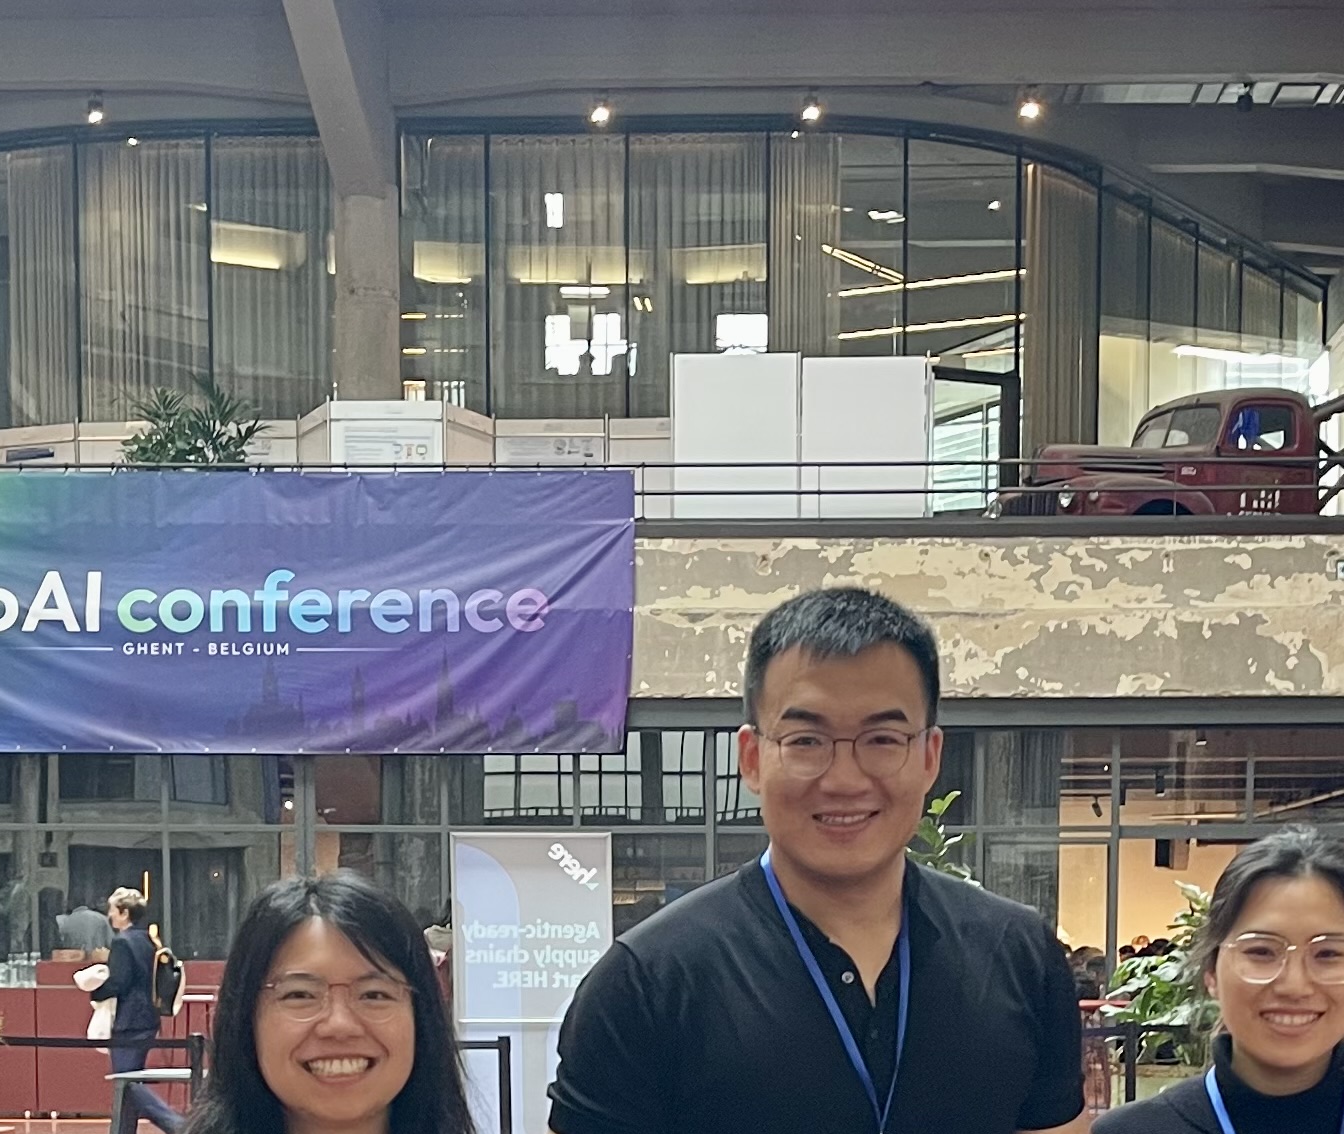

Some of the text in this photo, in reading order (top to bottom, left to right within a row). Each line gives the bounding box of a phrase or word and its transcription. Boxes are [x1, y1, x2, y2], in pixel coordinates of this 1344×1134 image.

[117, 569, 549, 633] conference
[122, 642, 185, 656] GHENT
[209, 642, 290, 656] BELGIUM
